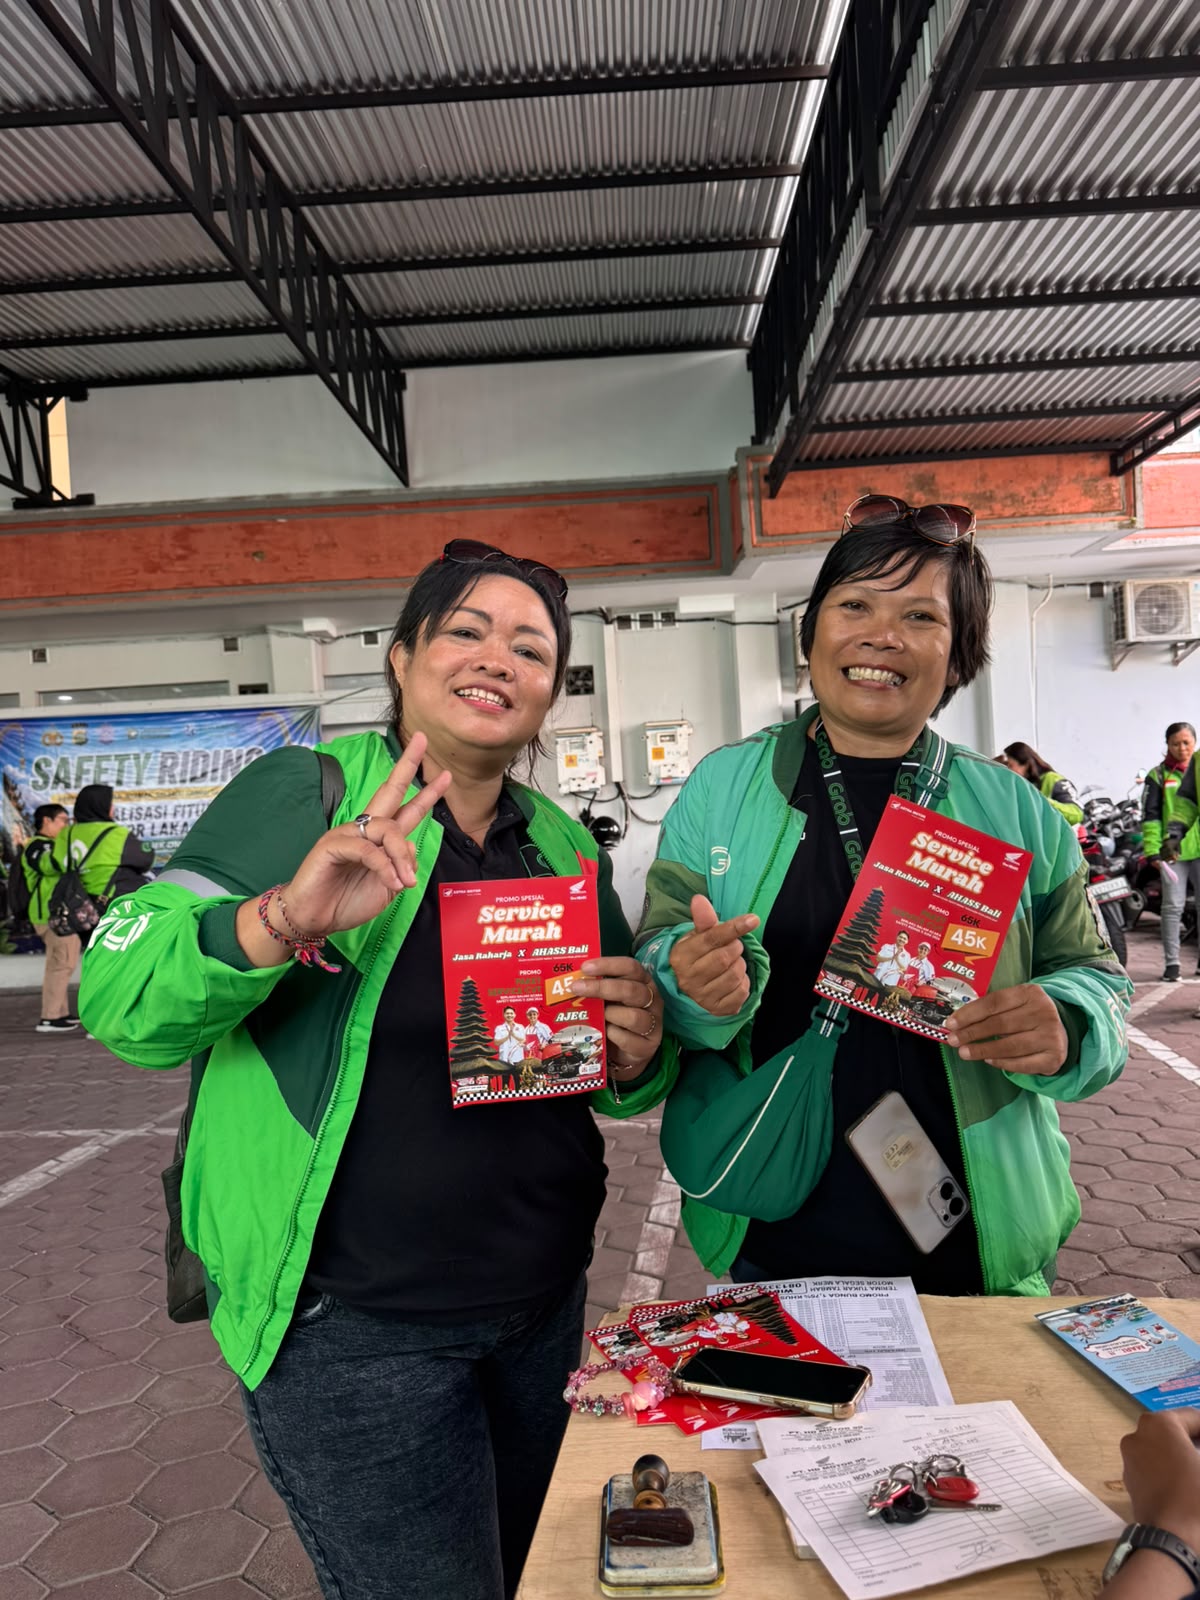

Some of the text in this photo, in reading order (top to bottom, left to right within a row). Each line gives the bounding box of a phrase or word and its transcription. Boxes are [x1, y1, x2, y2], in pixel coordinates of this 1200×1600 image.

[816, 731, 837, 769] Grab
[31, 753, 152, 791] SAFETY
[898, 773, 915, 800] Gra
[828, 782, 854, 826] Grab
[934, 829, 980, 853] PROMO SPESIAL
[910, 832, 994, 876] Service
[905, 851, 985, 895] Murah
[521, 894, 545, 902] SPESIAL
[873, 861, 895, 876] Jasa
[894, 867, 930, 889] Raharja
[947, 891, 980, 910] AHASS
[980, 904, 1002, 918] Bali
[478, 902, 564, 924] Service
[928, 904, 950, 917] PROMO
[961, 913, 981, 928] 65K
[481, 920, 562, 944] Murah
[950, 928, 987, 950] 45K
[452, 953, 475, 962] Jasa
[475, 950, 512, 961] Raharja
[532, 947, 567, 957] AHASS
[567, 944, 589, 954] Bali
[553, 963, 575, 972] 65K
[551, 976, 574, 996] 45
